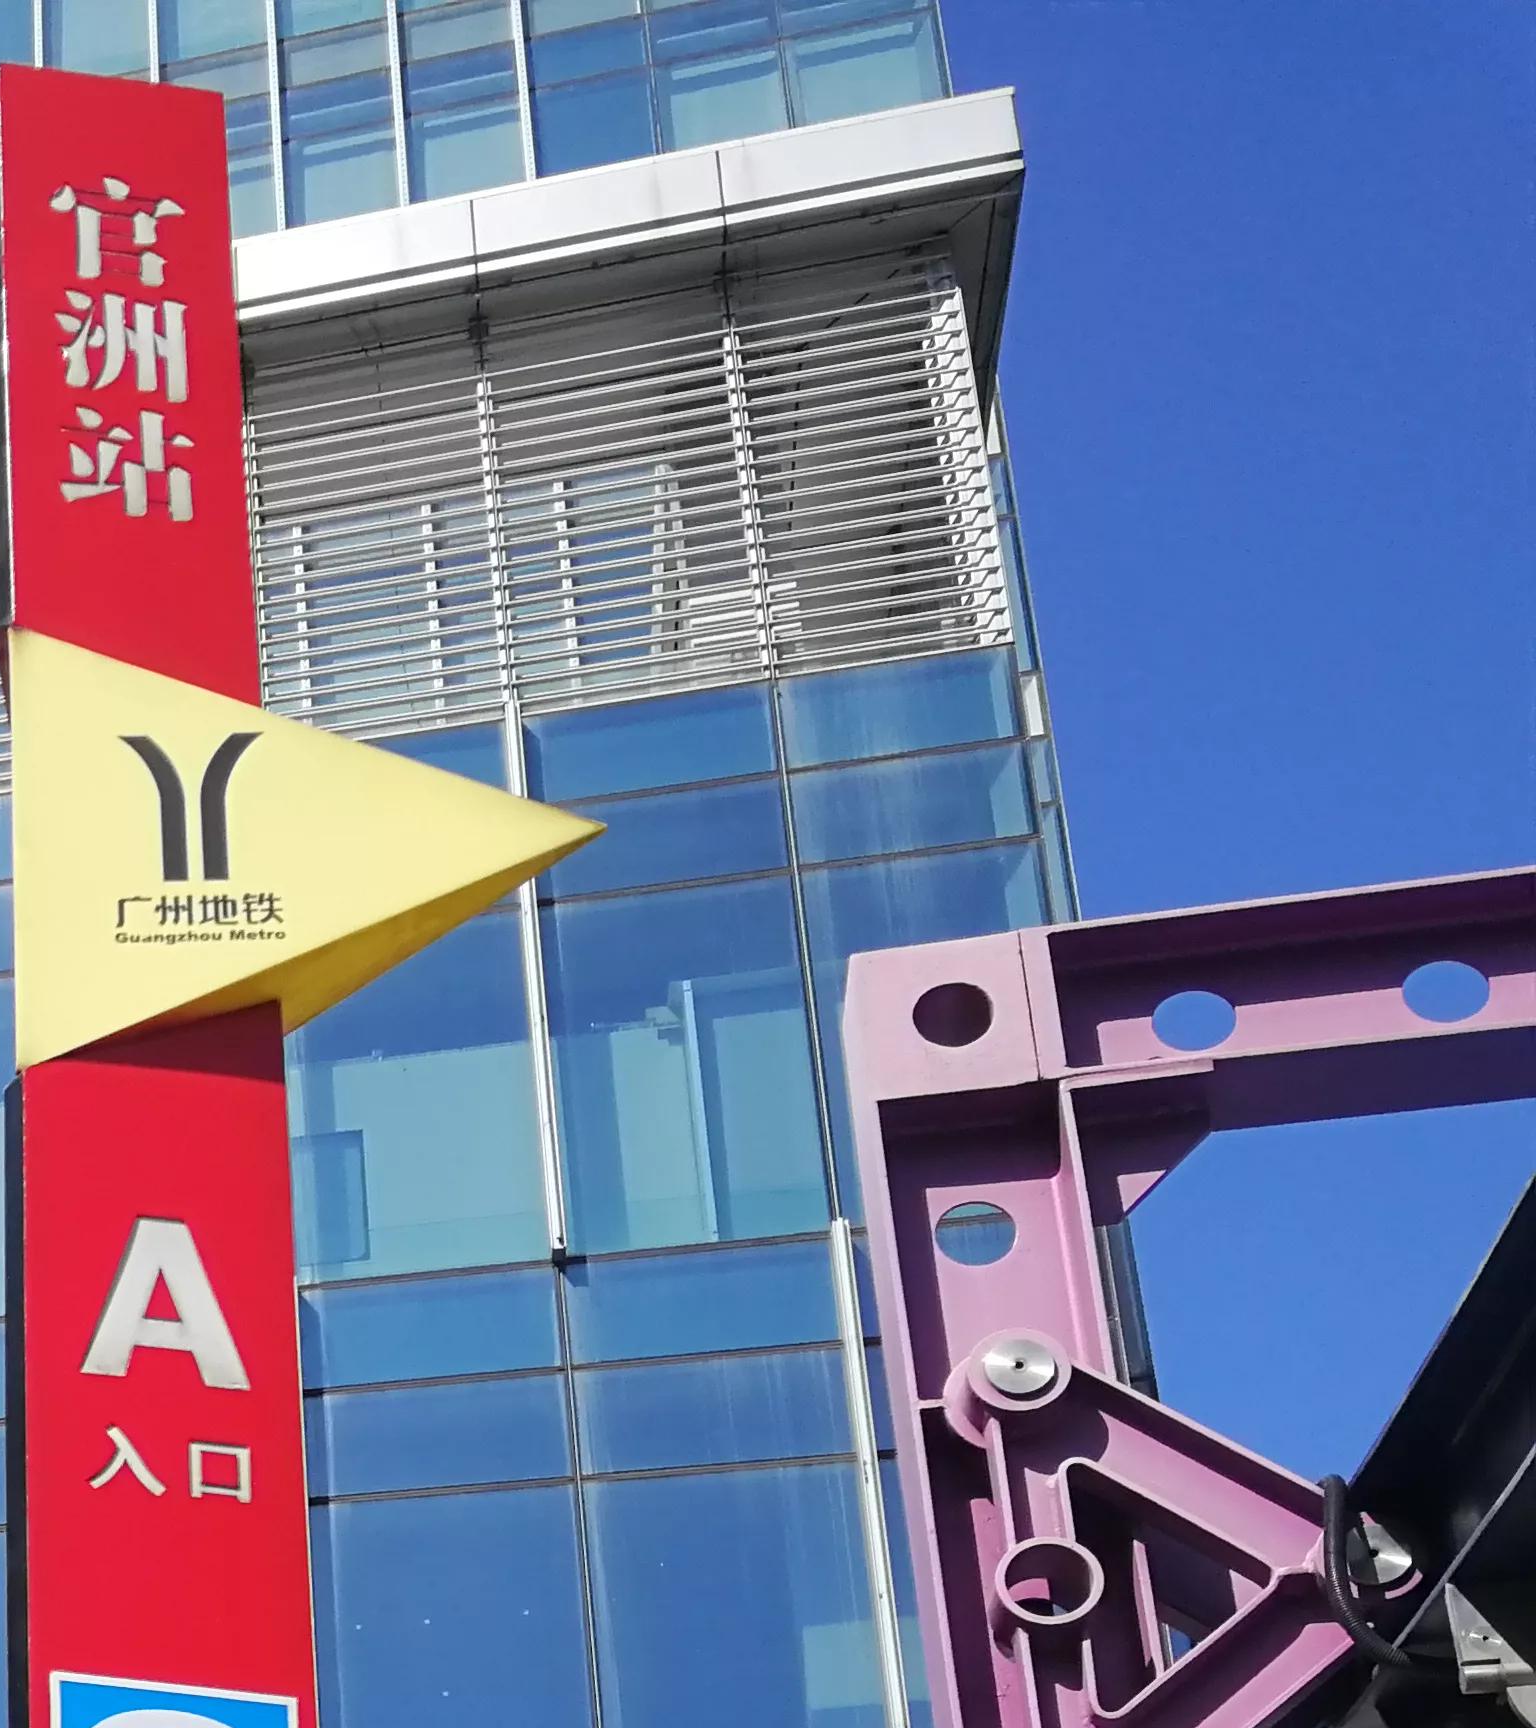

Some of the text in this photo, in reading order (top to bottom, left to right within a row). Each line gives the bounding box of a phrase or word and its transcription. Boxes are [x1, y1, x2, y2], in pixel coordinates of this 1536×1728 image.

[50, 176, 195, 523] 官洲站
[115, 929, 287, 946] Guangzhou Metro
[116, 893, 285, 928] 广州地铁
[80, 1216, 251, 1391] A
[88, 1424, 253, 1505] 入口
